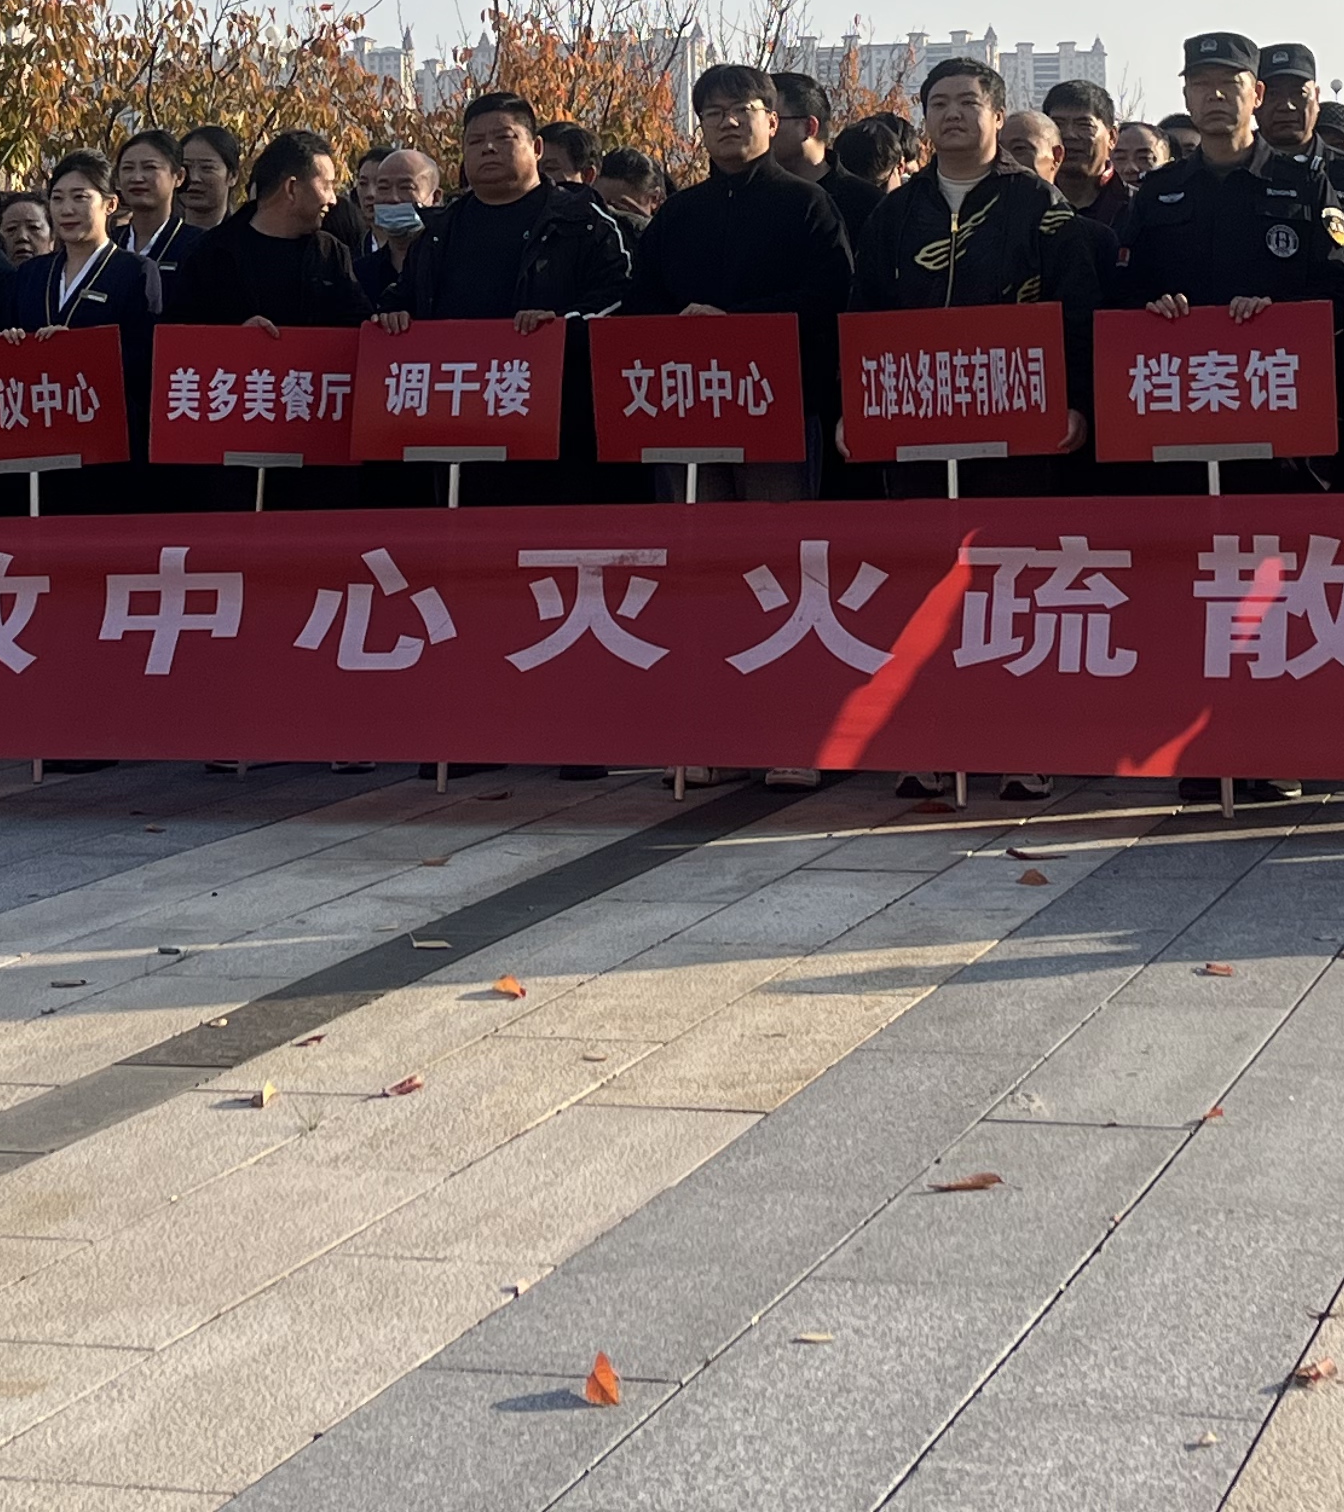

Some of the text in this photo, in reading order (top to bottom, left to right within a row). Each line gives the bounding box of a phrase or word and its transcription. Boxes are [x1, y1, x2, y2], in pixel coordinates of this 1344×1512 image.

[167, 368, 351, 421] 美多美餐厅
[385, 360, 531, 417] 调干楼
[621, 360, 774, 418] 文印中心
[862, 347, 1046, 420] 江淮公务用车有限公司
[1129, 348, 1299, 414] 档案馆
